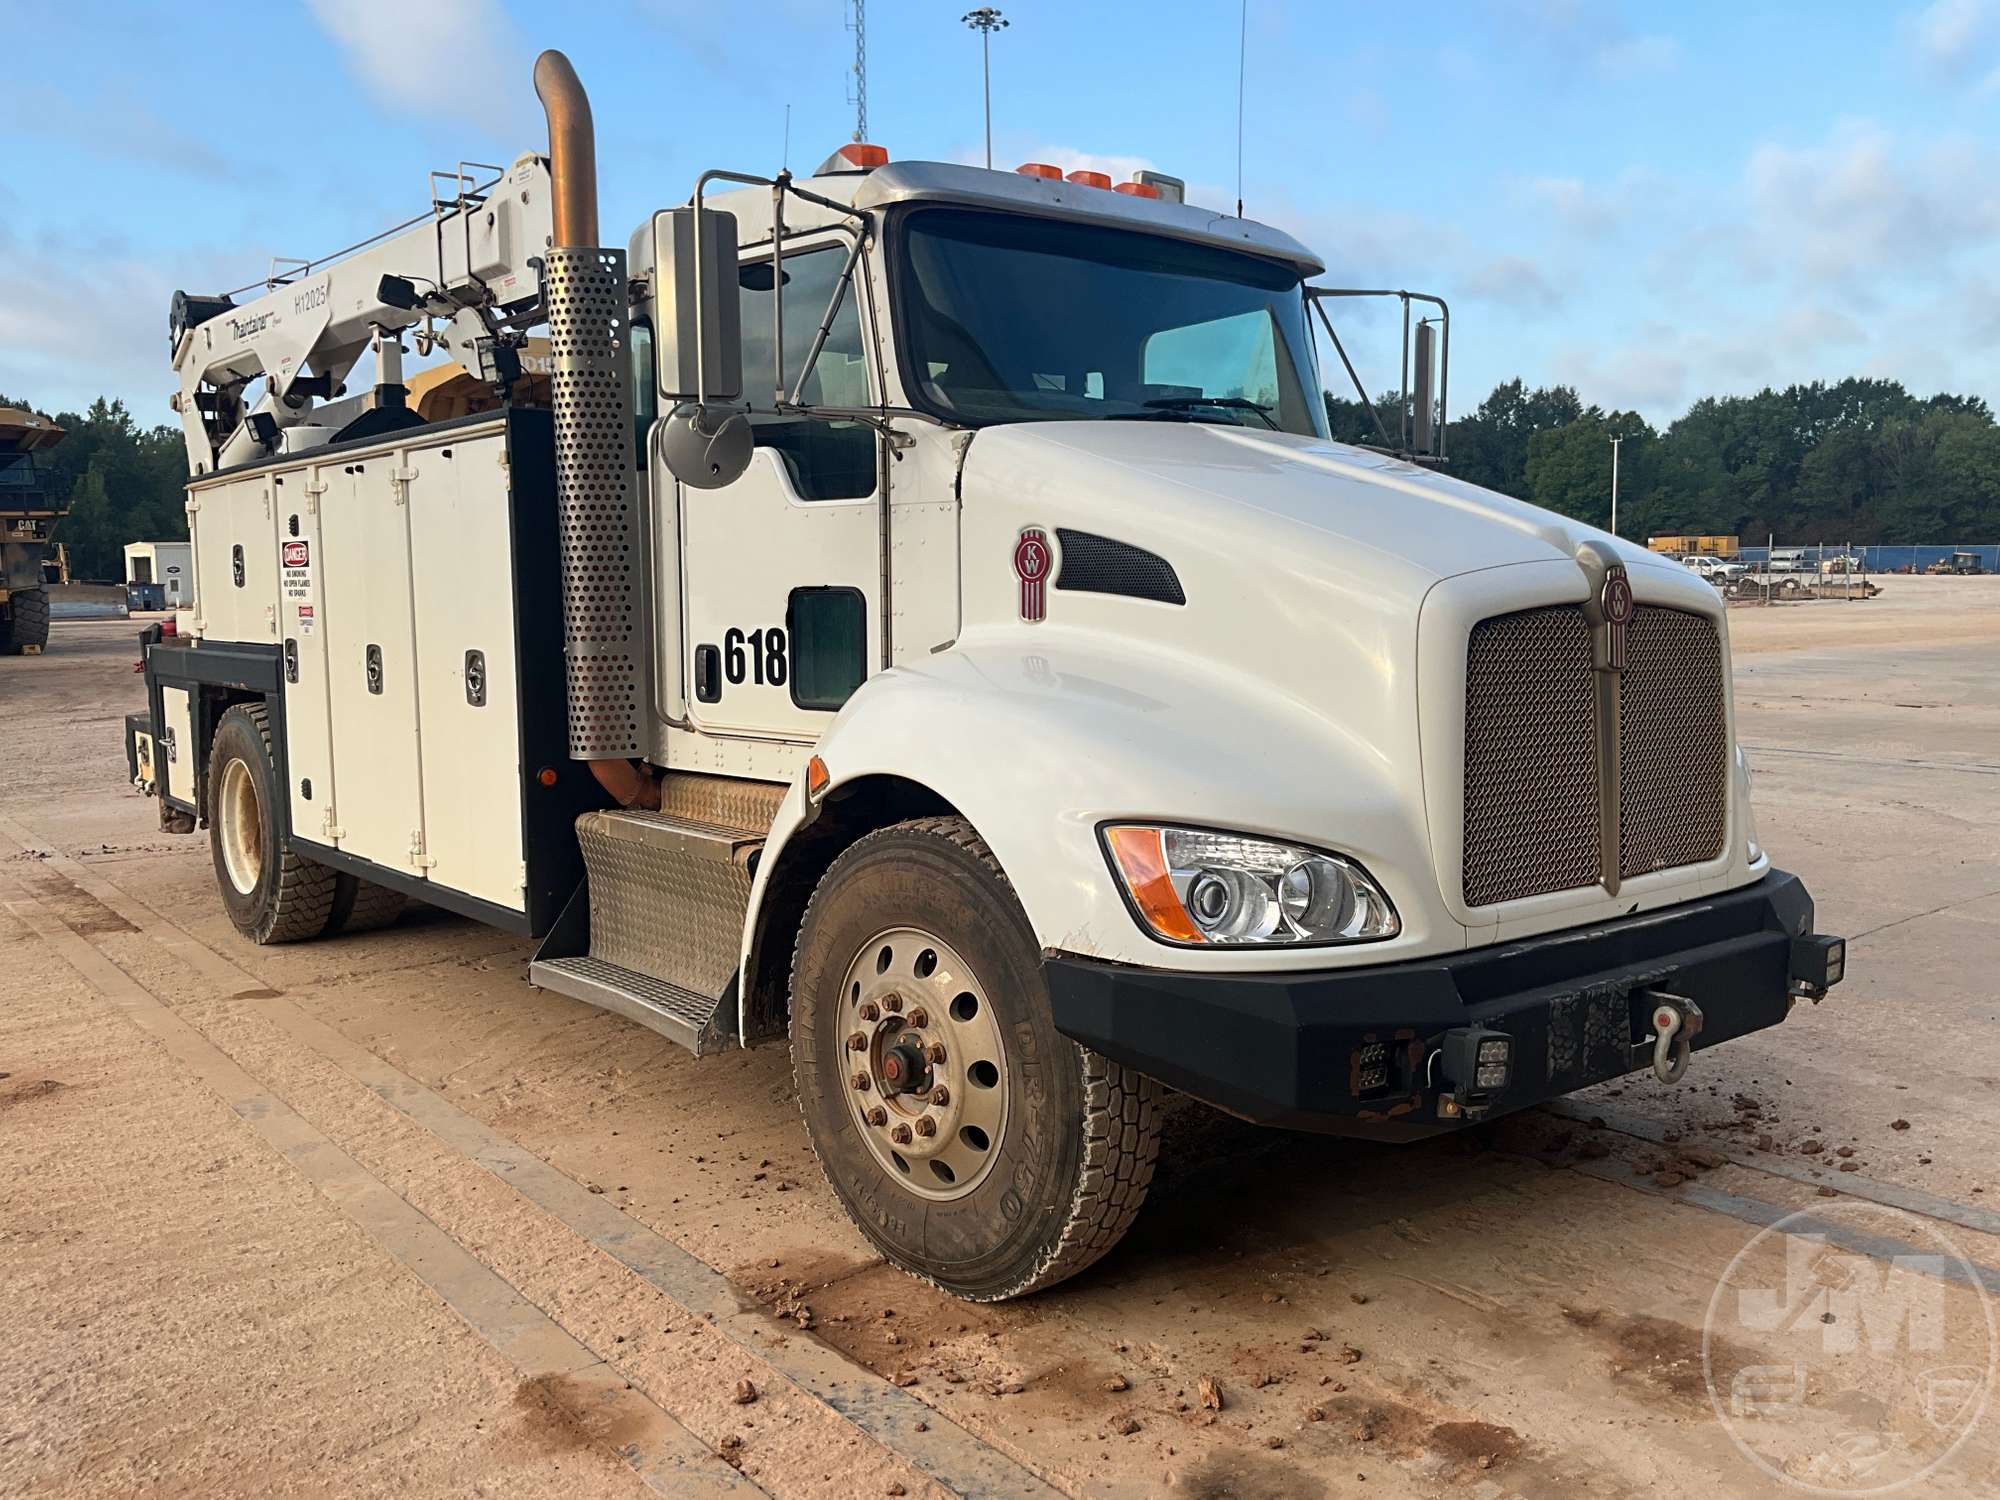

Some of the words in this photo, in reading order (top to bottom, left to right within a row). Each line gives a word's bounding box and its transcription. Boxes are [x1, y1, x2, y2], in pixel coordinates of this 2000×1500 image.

[18, 519, 37, 531] CAT
[284, 547, 308, 561] DANGER
[298, 579, 310, 587] FLAMES
[294, 589, 306, 597] SPARKS
[724, 627, 787, 686] 618
